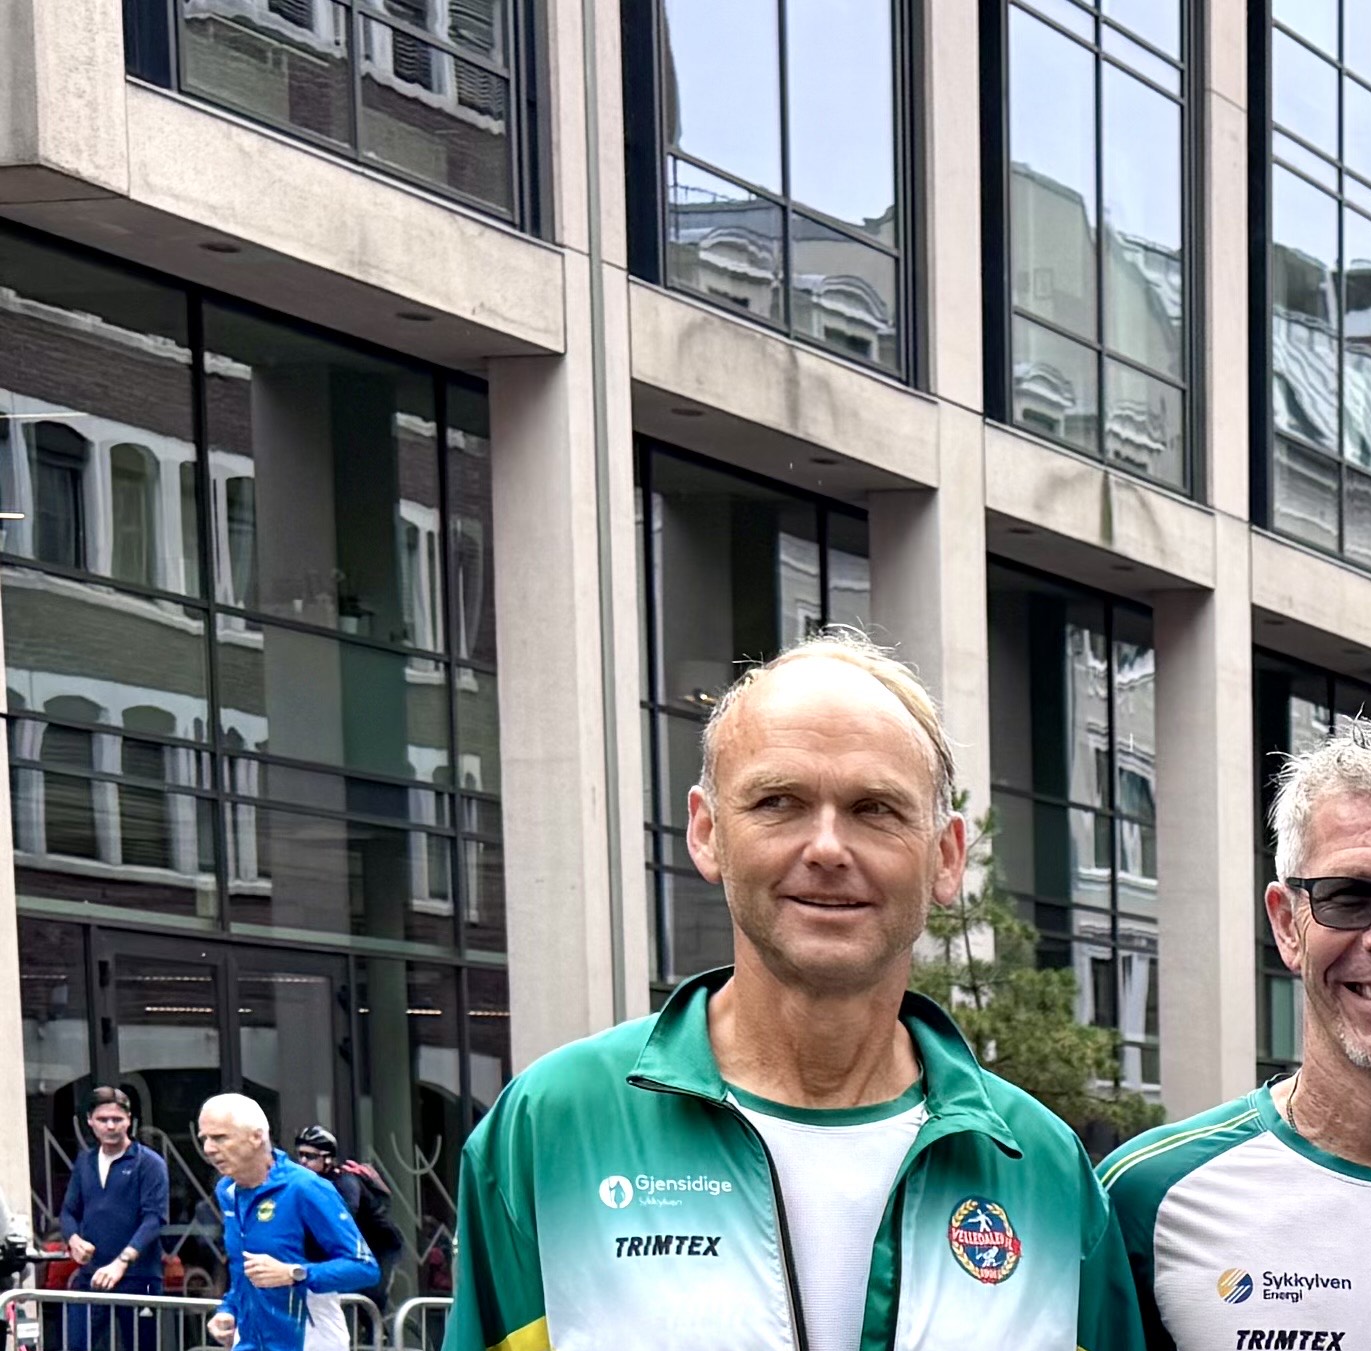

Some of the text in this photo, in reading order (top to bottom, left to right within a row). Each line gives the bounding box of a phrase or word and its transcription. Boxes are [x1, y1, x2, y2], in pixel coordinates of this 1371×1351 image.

[635, 1174, 733, 1195] Gjensidige
[615, 1235, 722, 1258] TRIMTEX
[1262, 1271, 1352, 1292] Sykkylven
[1262, 1289, 1303, 1303] Energi
[1235, 1330, 1346, 1351] TRIMTEX
